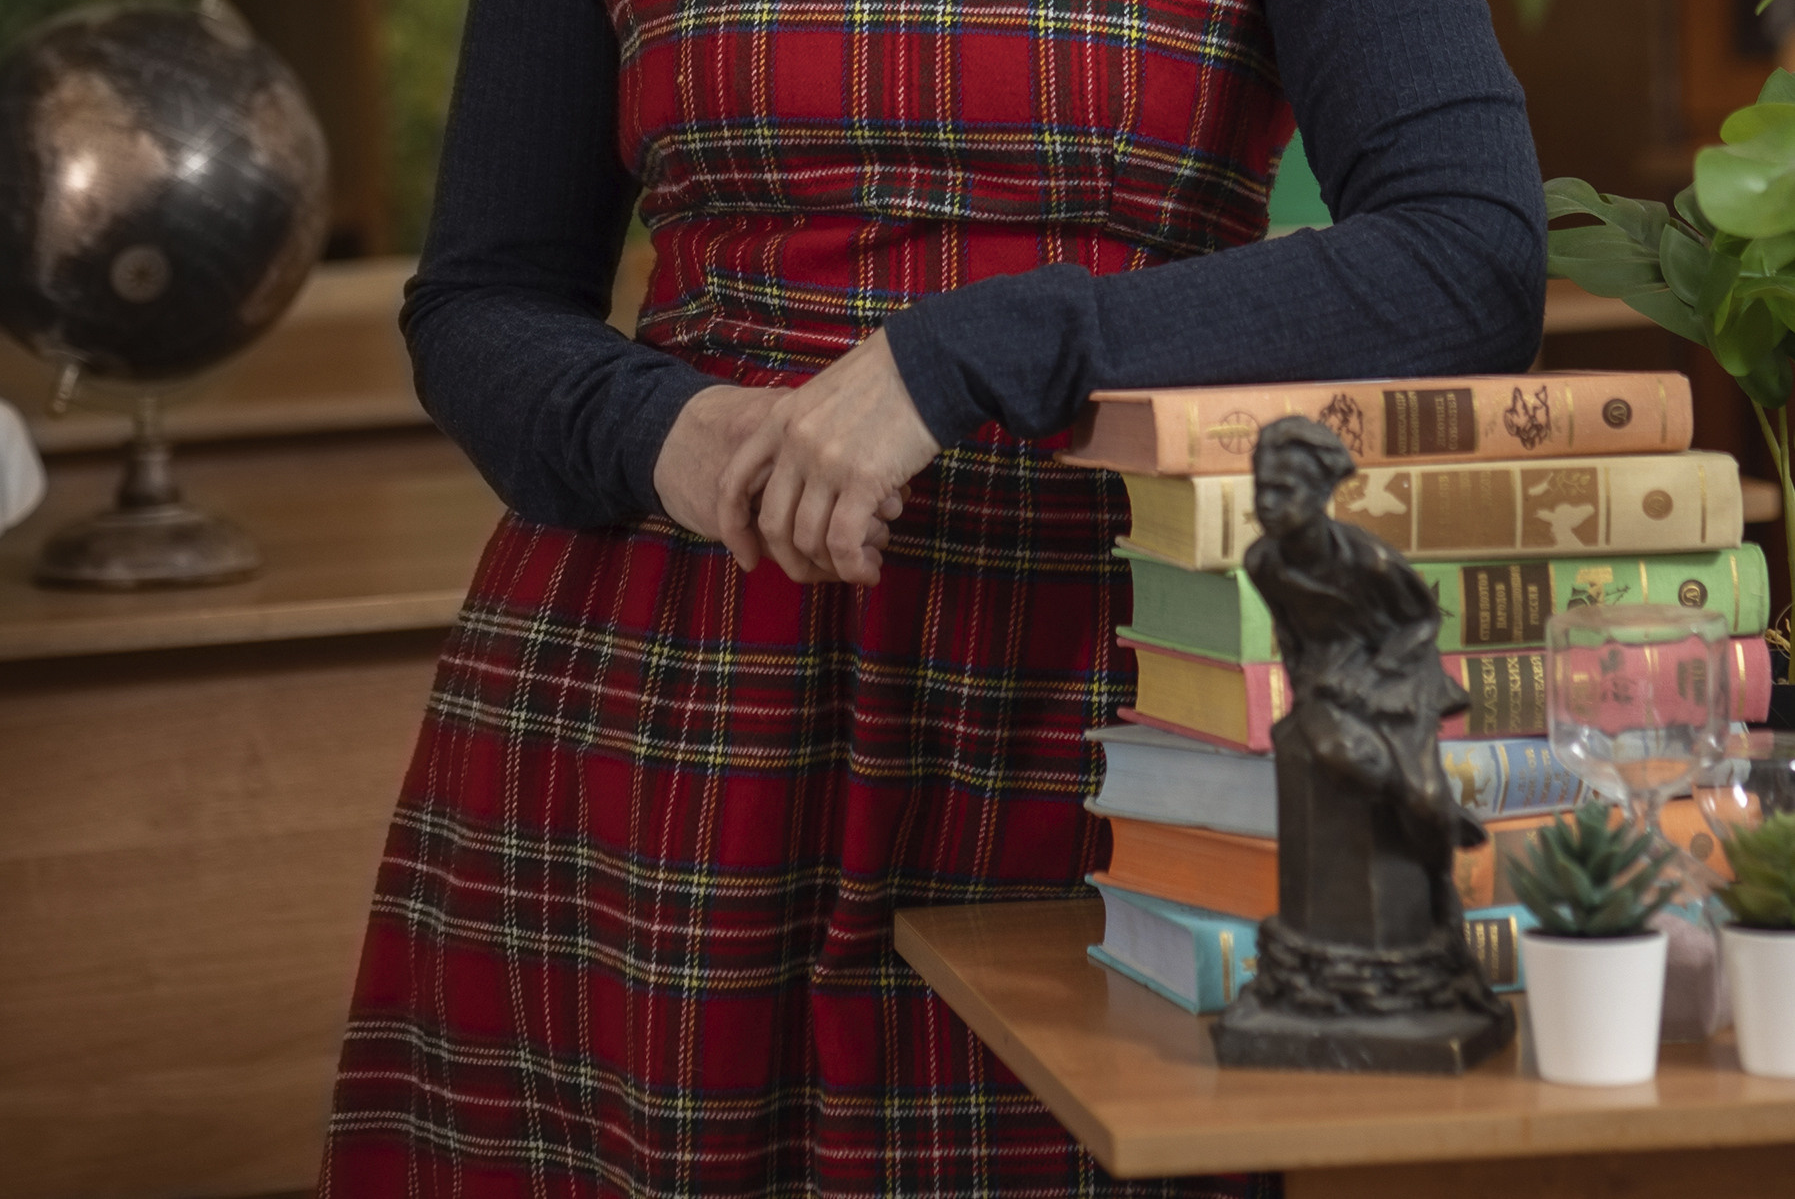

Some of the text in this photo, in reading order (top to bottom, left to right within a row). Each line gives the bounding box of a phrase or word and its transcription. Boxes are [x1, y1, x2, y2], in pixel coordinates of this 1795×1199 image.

[1494, 583, 1507, 629] НАРОДОВ
[1527, 585, 1539, 625] РОССИИ
[1481, 657, 1498, 734] СКАЗКИ
[1507, 657, 1522, 733] РУССКИХ
